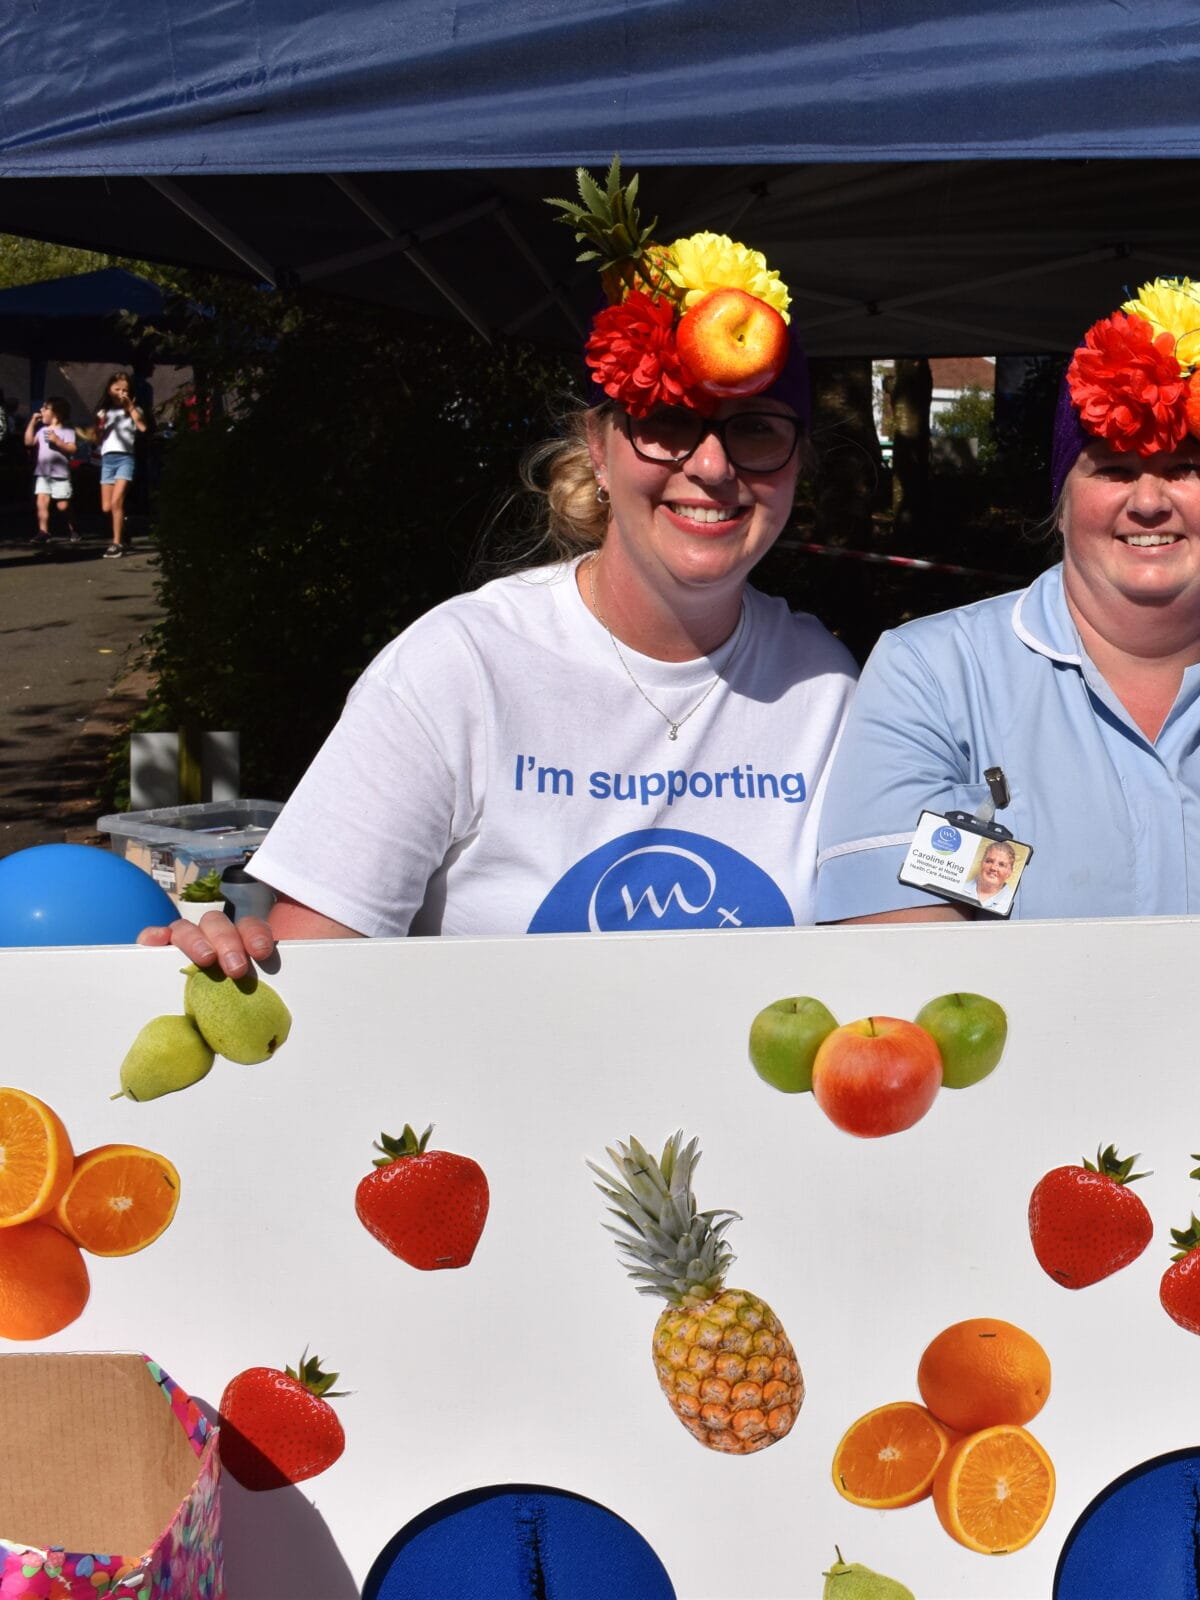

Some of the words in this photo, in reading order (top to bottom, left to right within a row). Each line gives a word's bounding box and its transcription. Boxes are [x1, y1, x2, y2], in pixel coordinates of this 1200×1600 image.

[514, 754, 574, 796] I'm
[588, 764, 807, 806] supporting
[912, 849, 944, 865] Caroline
[946, 860, 965, 874] King
